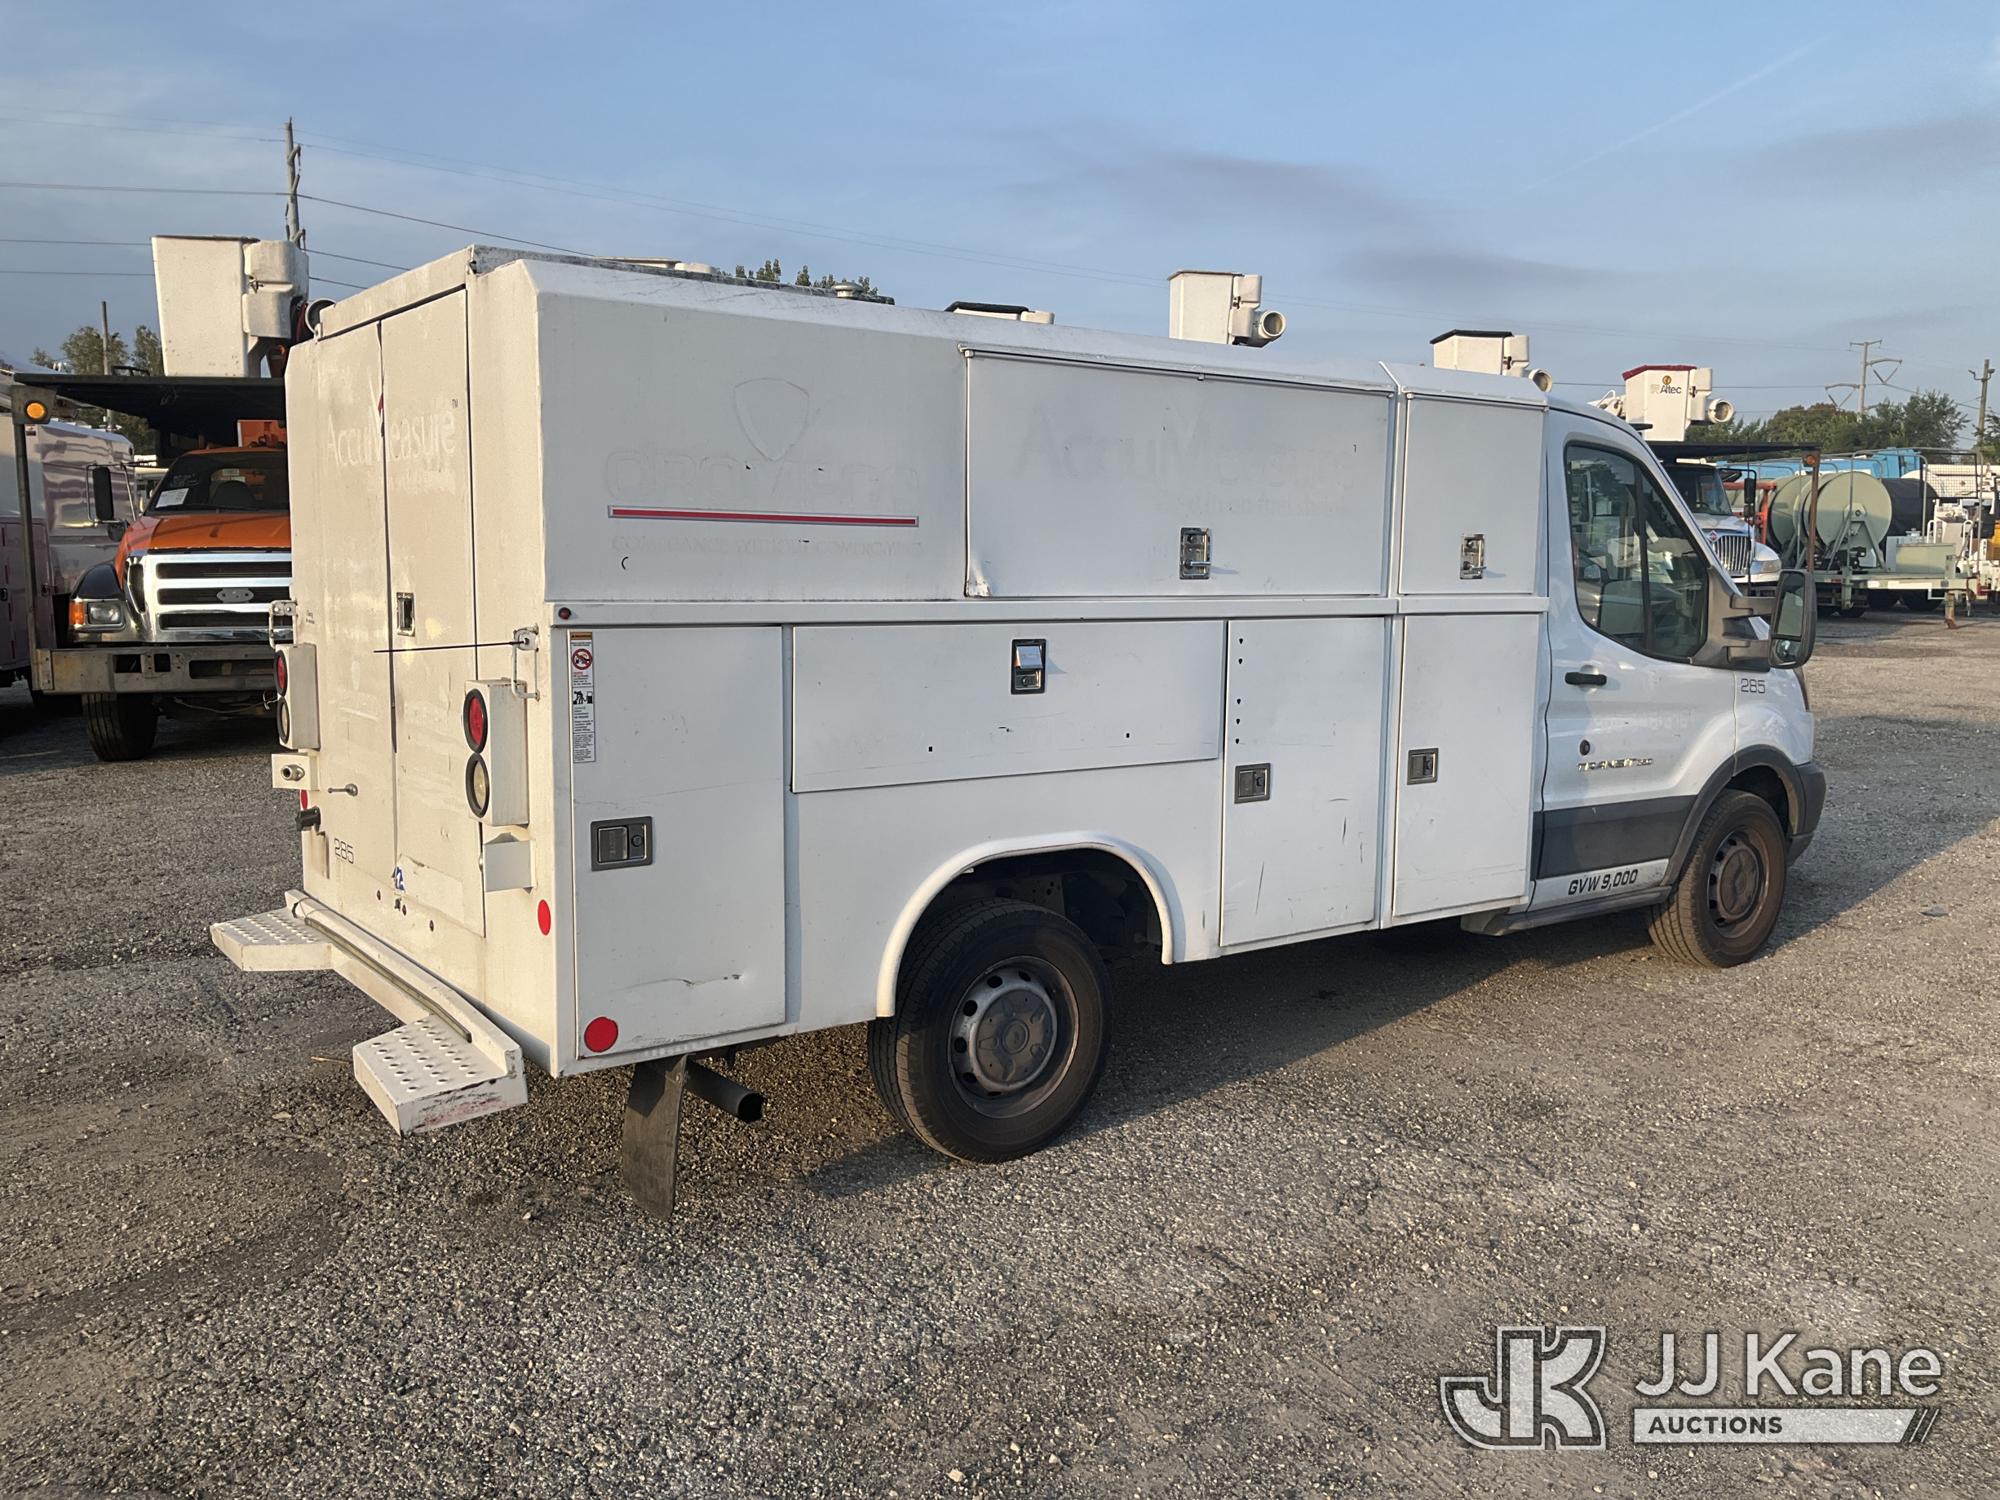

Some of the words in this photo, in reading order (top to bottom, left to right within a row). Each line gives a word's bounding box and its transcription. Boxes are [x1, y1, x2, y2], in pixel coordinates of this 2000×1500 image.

[1660, 384, 1682, 394] Altec
[1740, 678, 1766, 694] 285
[333, 837, 354, 865] 285
[1568, 875, 1600, 895] GVW
[1601, 869, 1638, 891] 9,000
